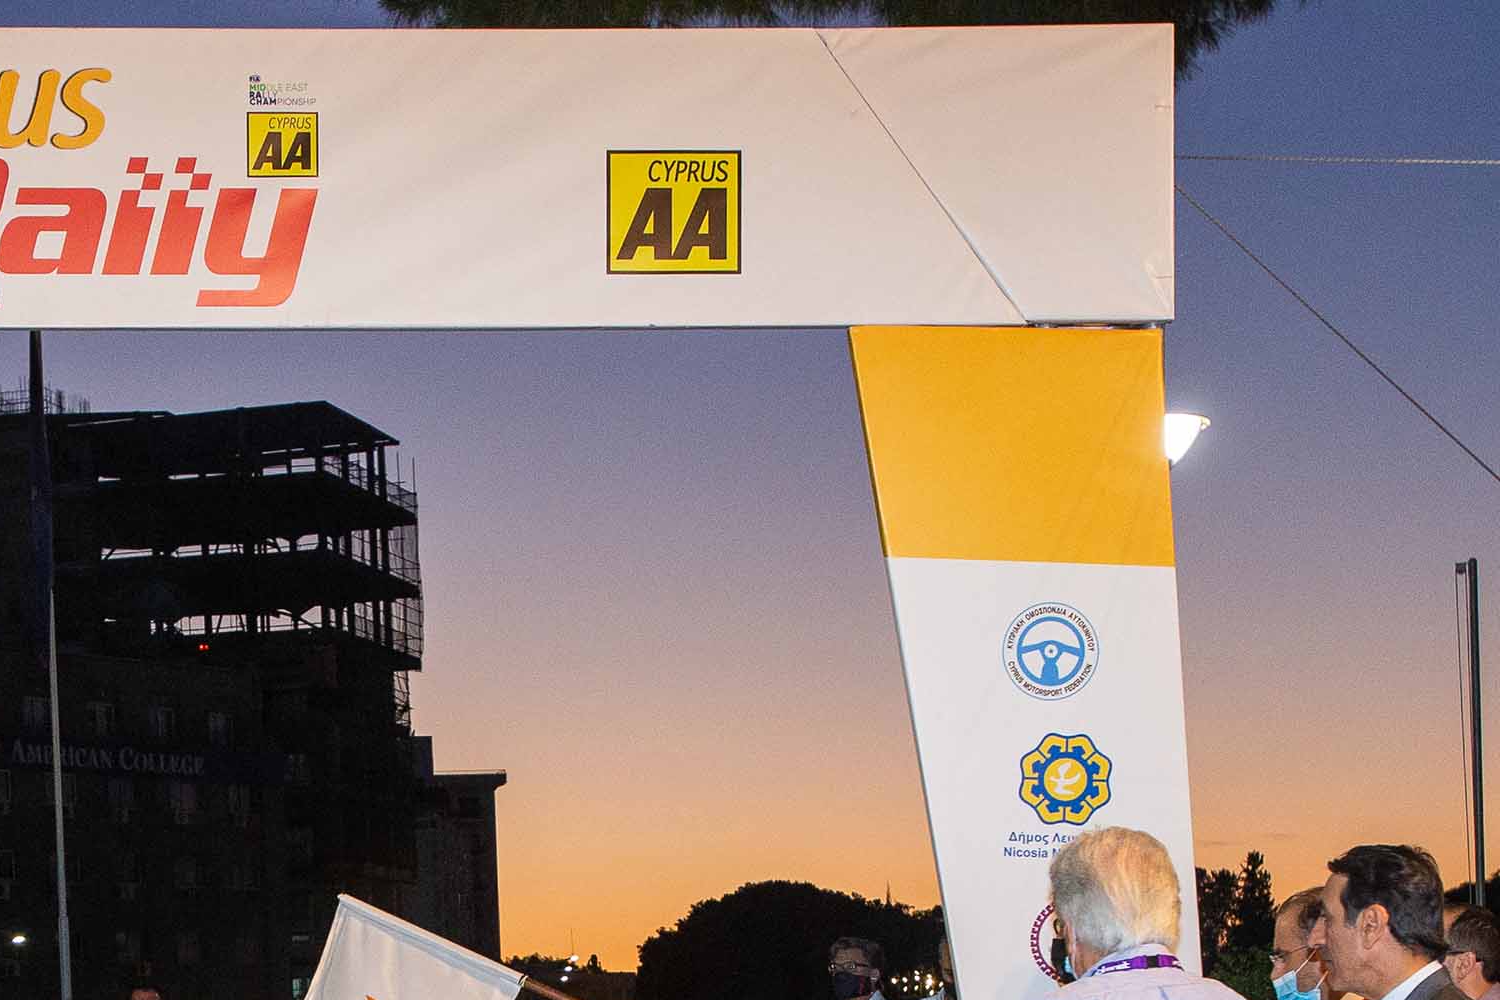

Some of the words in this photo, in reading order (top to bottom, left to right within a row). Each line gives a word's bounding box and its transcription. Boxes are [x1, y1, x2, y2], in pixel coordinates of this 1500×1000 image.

[269, 117, 311, 129] CYPRUS
[252, 132, 311, 170] AA
[648, 160, 729, 182] CYPRUS
[616, 187, 727, 260] AA
[1009, 832, 1049, 845] Δήμος
[1003, 846, 1048, 858] Nicosia
